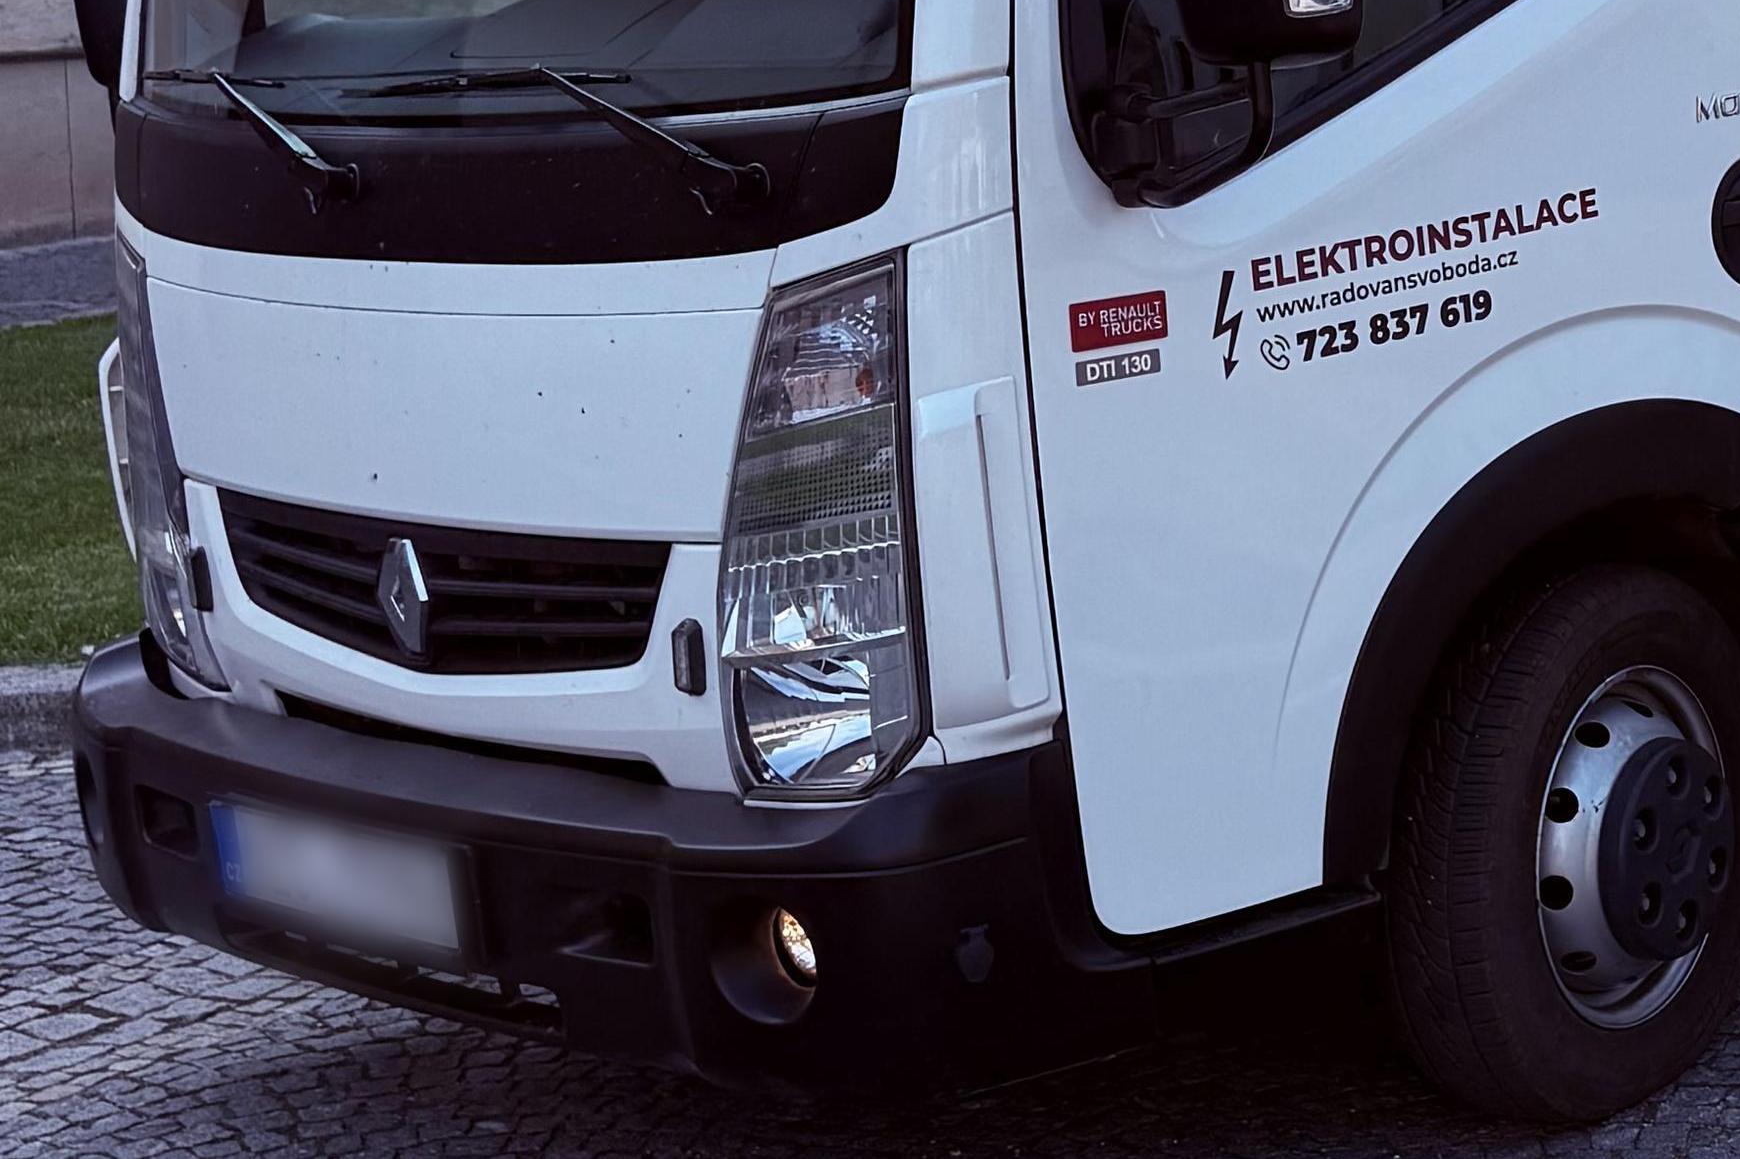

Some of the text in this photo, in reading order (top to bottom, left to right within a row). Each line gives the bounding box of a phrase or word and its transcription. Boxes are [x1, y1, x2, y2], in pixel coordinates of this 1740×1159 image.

[1250, 188, 1599, 292] ELEKTROINSTALACE
[1256, 250, 1519, 323] www.radovansvoboda.cz
[1078, 301, 1161, 327] BY RENAULT
[1100, 315, 1163, 338] TRUCKS
[1296, 290, 1492, 362] 723 837 619
[1086, 354, 1152, 382] DTI 130
